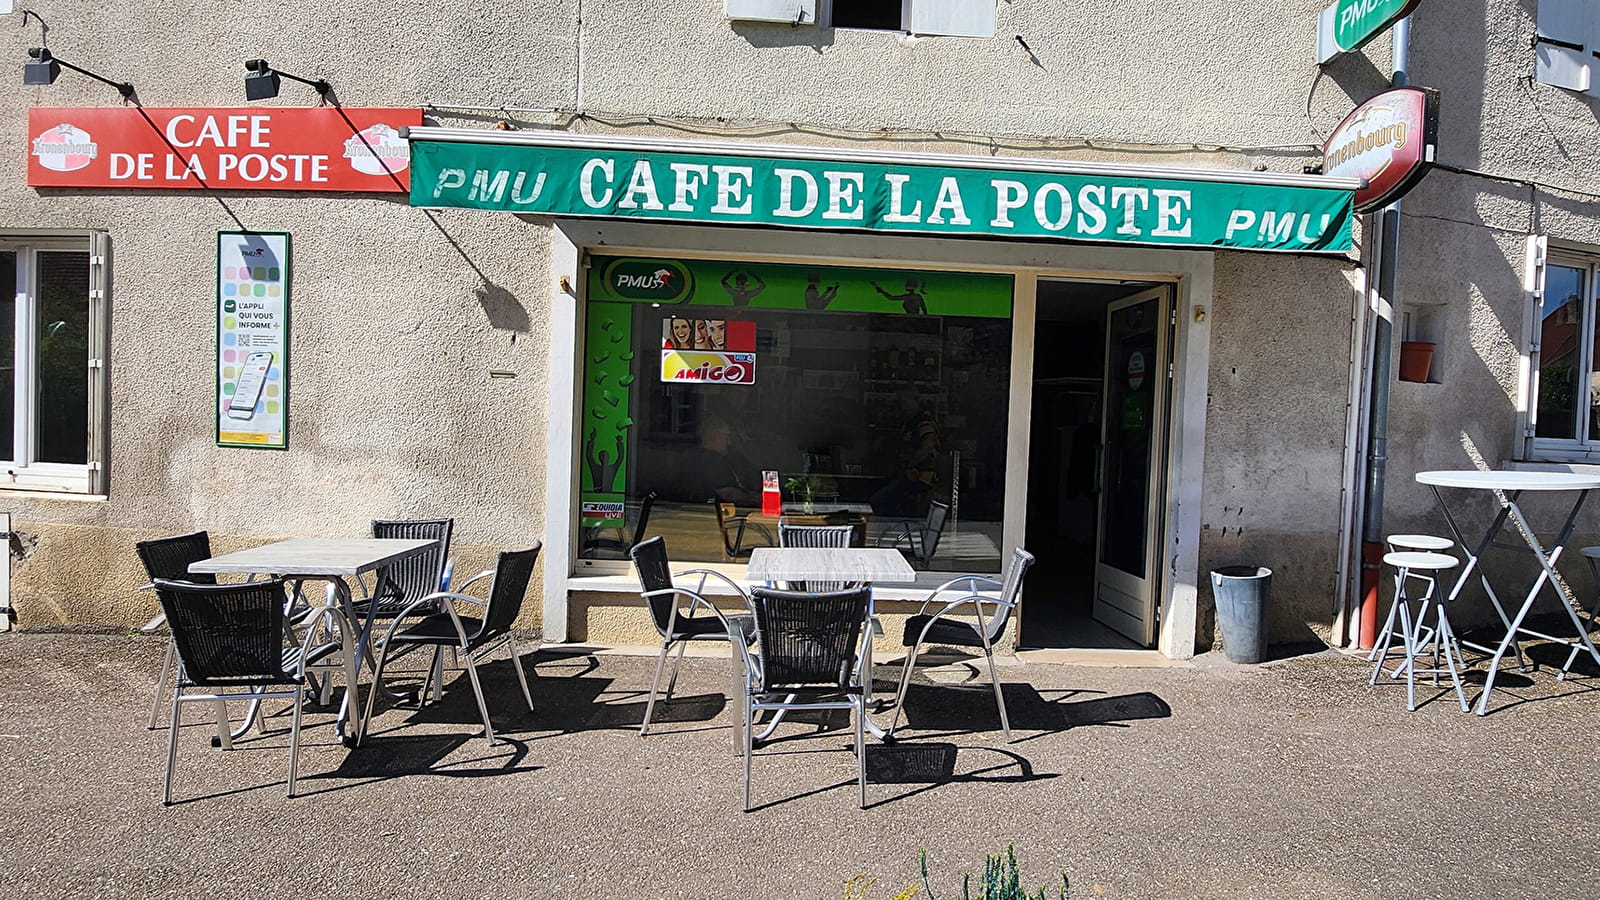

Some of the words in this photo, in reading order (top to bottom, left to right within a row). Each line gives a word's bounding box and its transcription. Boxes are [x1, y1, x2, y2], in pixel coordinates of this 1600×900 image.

[165, 114, 271, 148] CAFE
[1327, 121, 1407, 174] ronenbourg
[109, 153, 154, 181] DE
[165, 154, 207, 182] LA
[217, 154, 329, 183] POSTE
[432, 167, 547, 205] PMU
[579, 157, 754, 214] CAFE
[772, 167, 865, 221] DE
[883, 174, 971, 226] LA
[991, 179, 1193, 238] POSTE
[1225, 209, 1330, 246] PMU
[616, 274, 653, 290] PMU
[238, 302, 265, 310] L'APPLI
[238, 312, 252, 320] QUI
[253, 312, 274, 320] VOUS
[238, 321, 272, 329] INFORME
